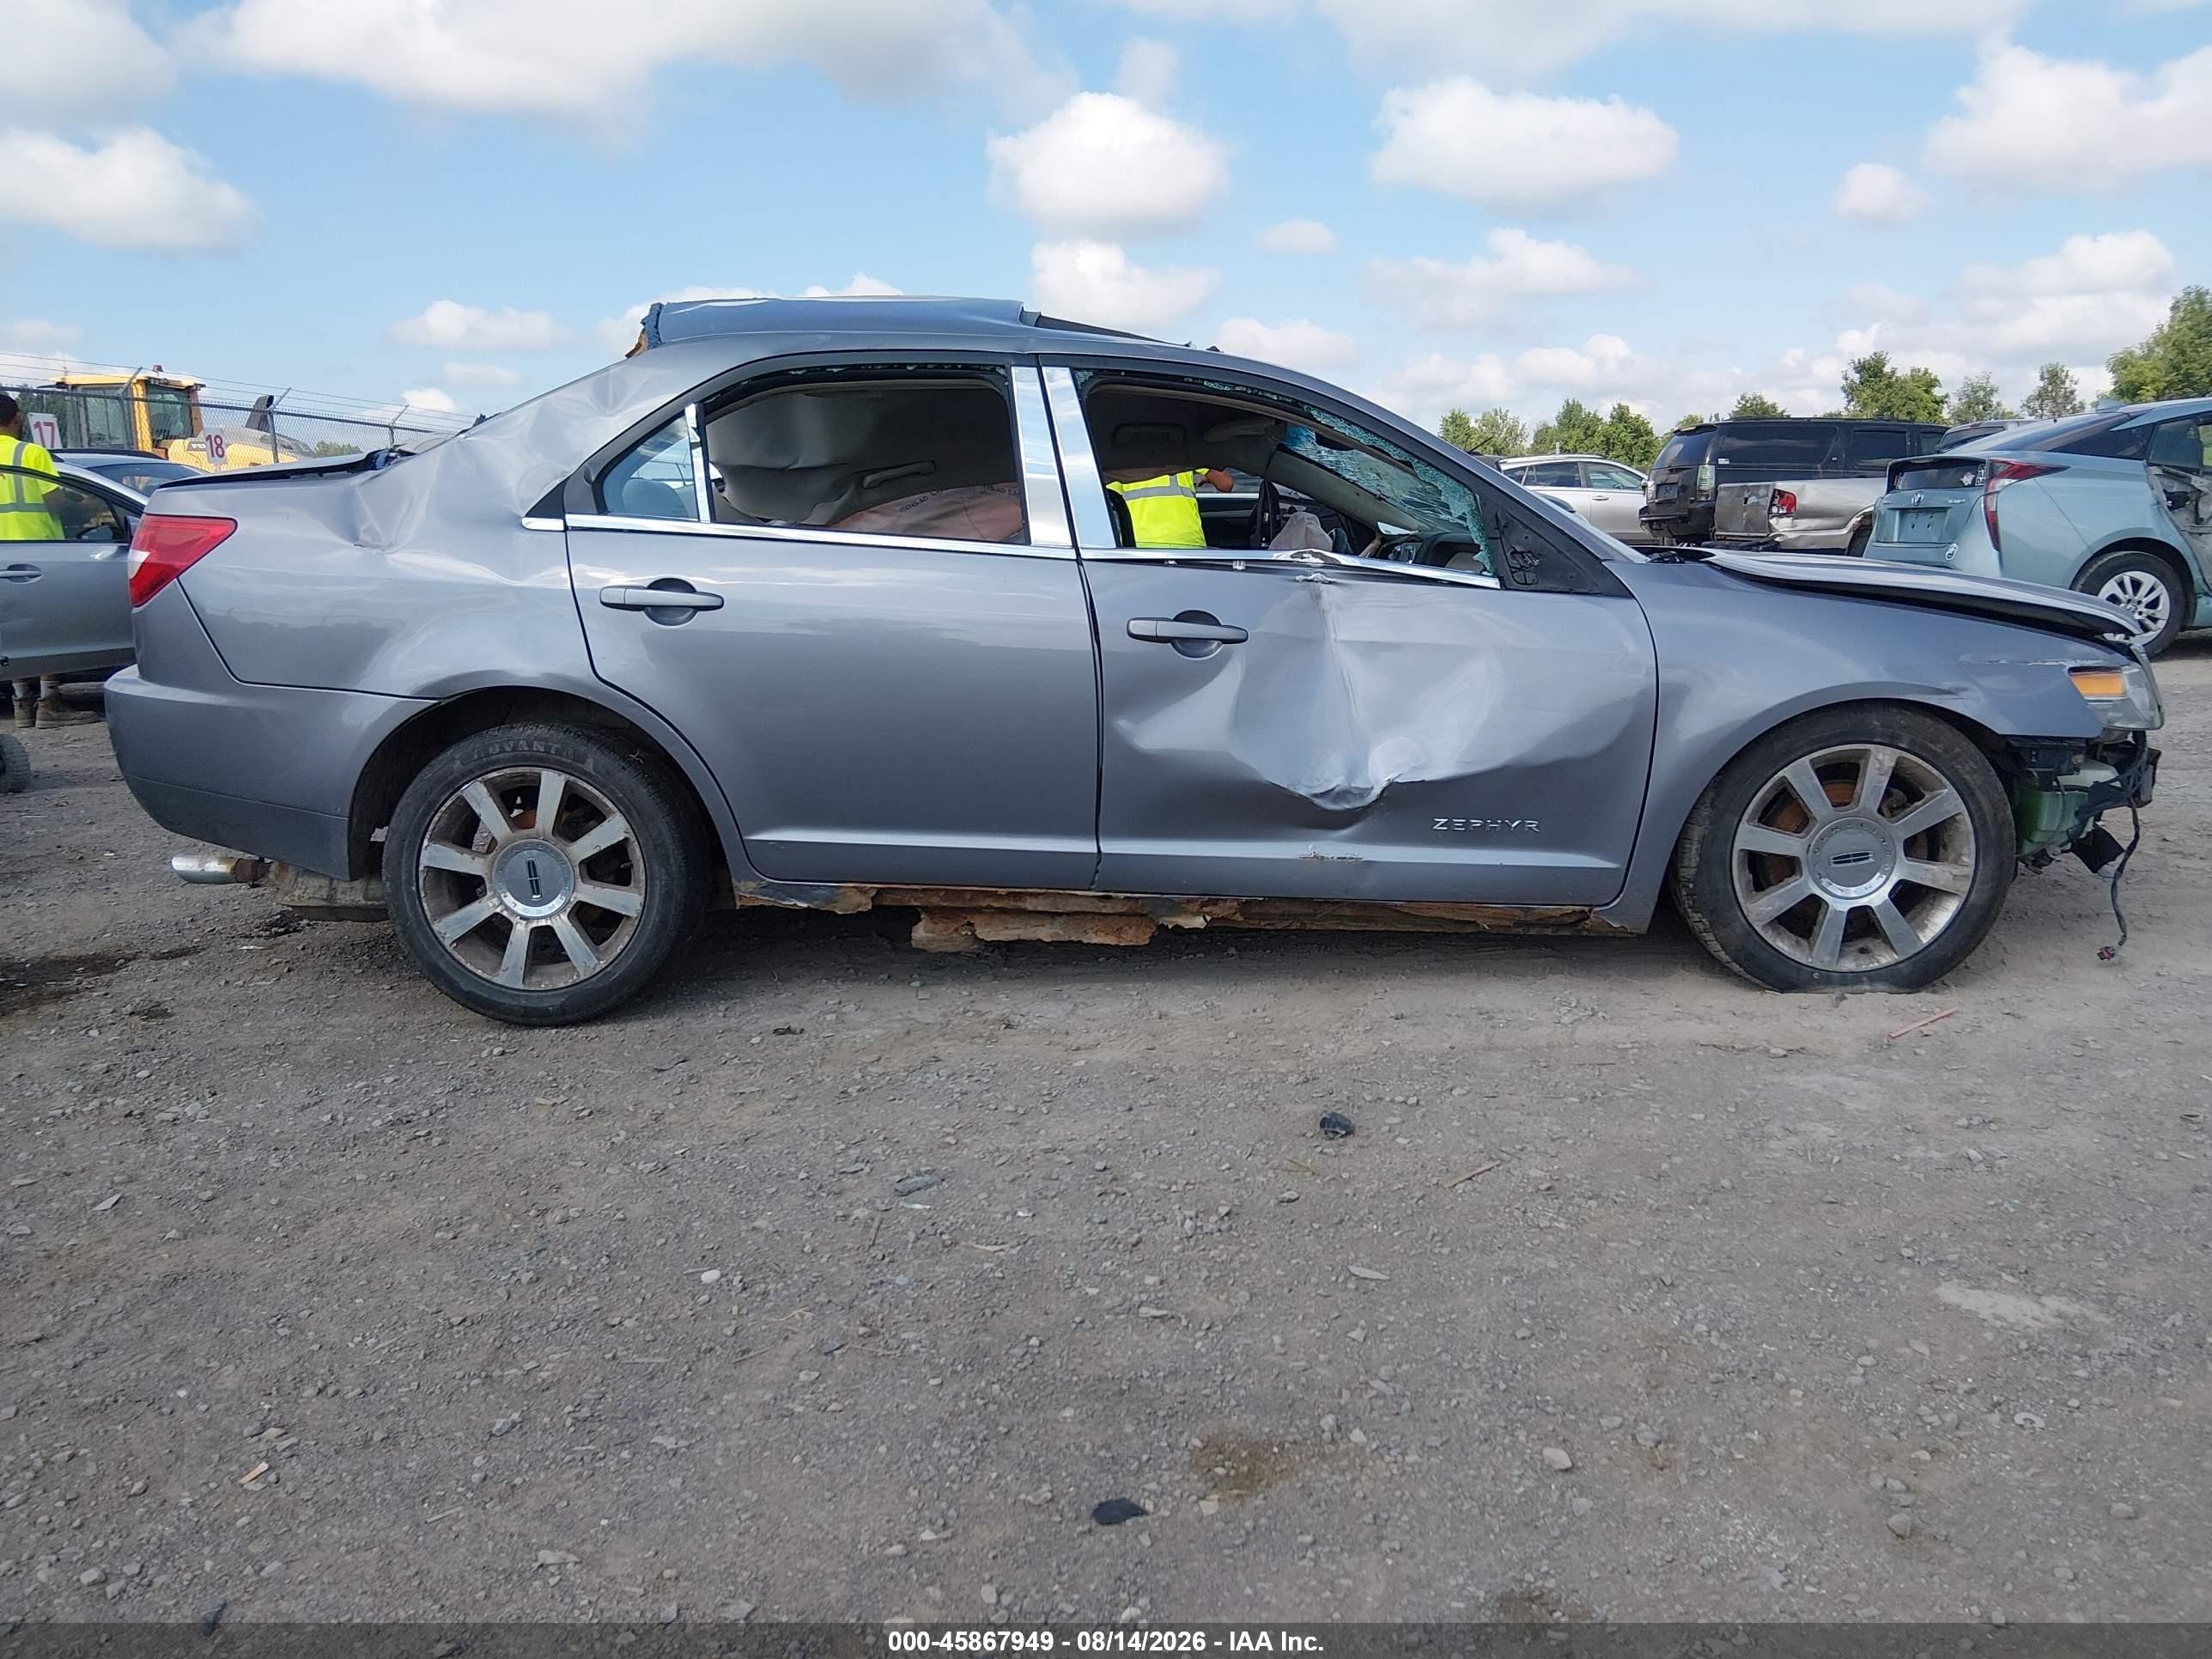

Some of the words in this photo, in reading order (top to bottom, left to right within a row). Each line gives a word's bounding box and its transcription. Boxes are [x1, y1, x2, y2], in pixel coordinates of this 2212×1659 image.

[33, 421, 55, 448] 17
[206, 434, 225, 458] 18
[1432, 817, 1540, 832] ZEPHYR
